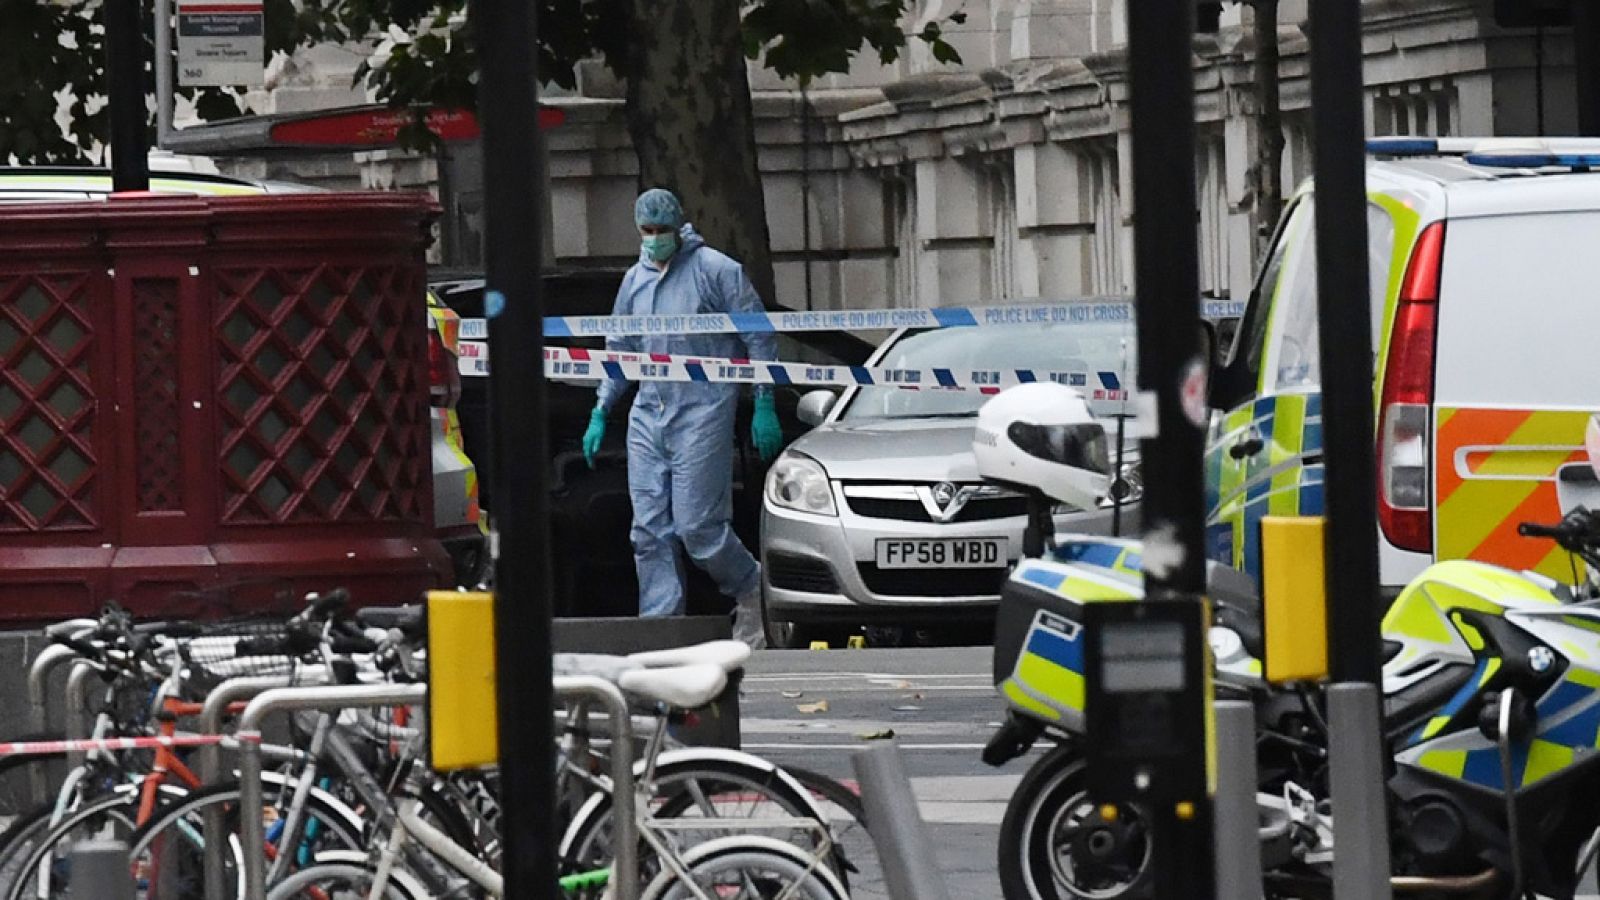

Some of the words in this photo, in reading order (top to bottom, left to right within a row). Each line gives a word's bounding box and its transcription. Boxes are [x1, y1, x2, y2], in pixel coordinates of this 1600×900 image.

[580, 318, 617, 333] POLICE
[620, 317, 643, 332] LINE
[646, 317, 661, 332] DO
[664, 316, 685, 331] NOT
[688, 314, 725, 331] CROSS
[782, 313, 820, 329] POLICE
[822, 312, 847, 327] LINE
[848, 311, 865, 327] DO
[866, 311, 888, 326] NOT
[891, 309, 928, 326] CROSS
[985, 307, 1022, 325] POLICE
[1025, 307, 1049, 323] LINE
[1051, 306, 1067, 322] DO
[1069, 305, 1091, 321] NOT
[1093, 304, 1129, 321] CROSS
[462, 320, 482, 336] NOT
[886, 541, 946, 564] FP58
[952, 540, 998, 563] WBD
